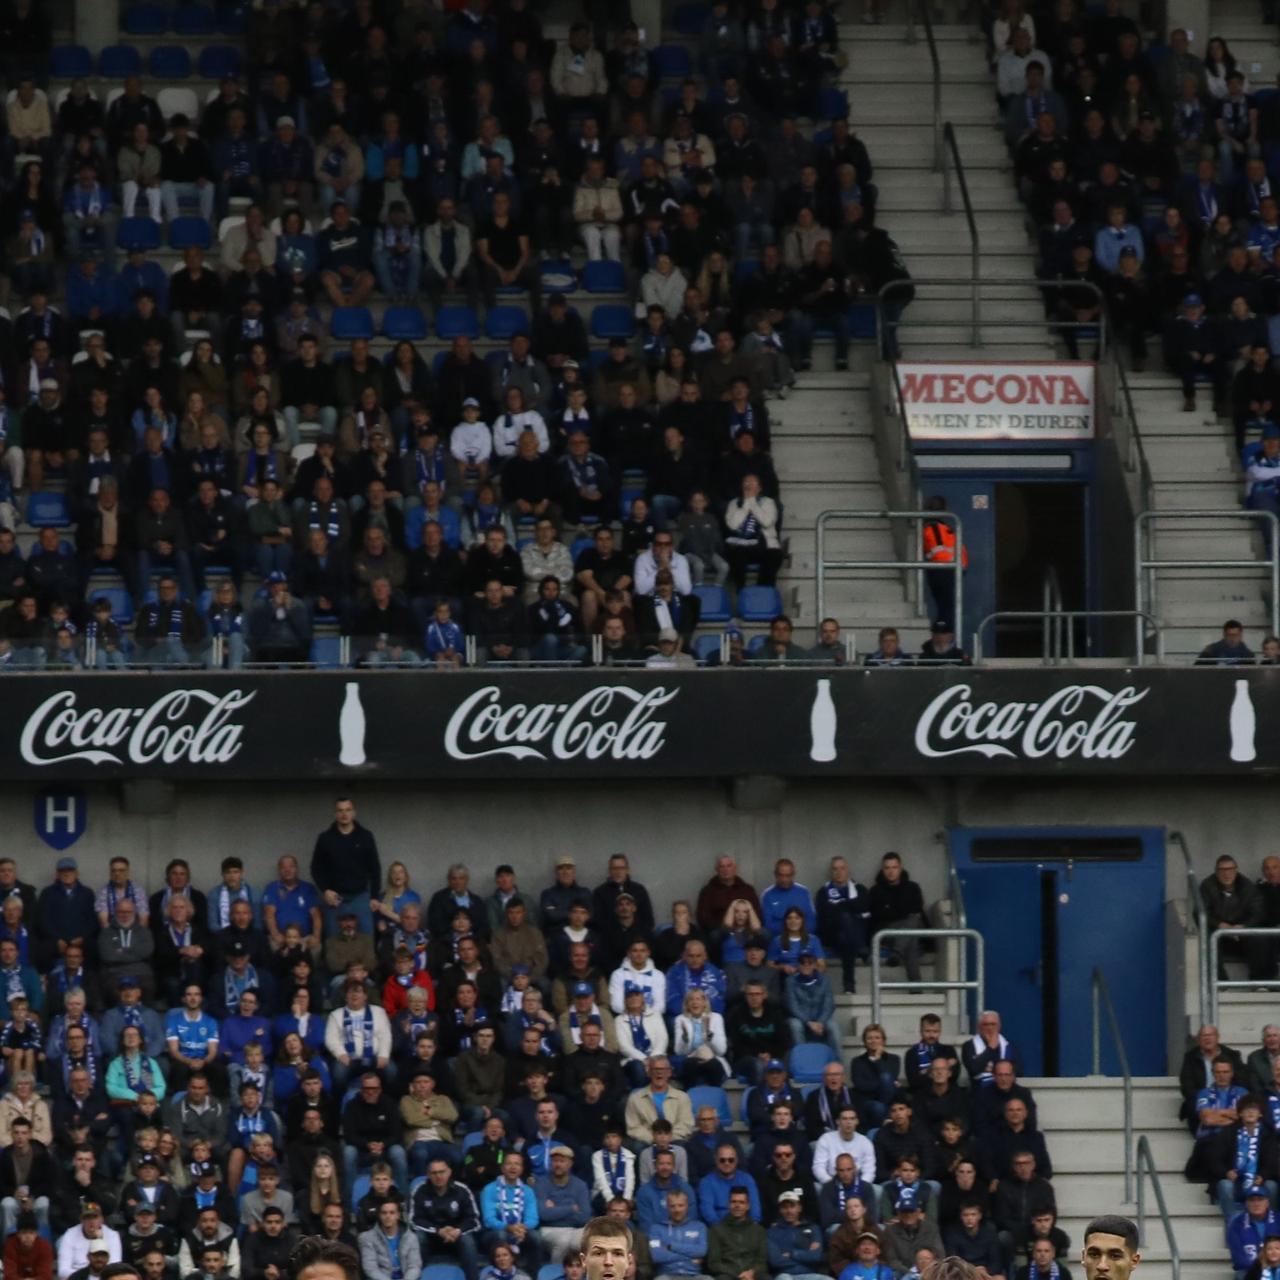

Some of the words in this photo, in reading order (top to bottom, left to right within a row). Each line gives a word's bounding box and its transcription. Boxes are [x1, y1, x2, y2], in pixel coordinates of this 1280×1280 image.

[899, 373, 1090, 404] MECONA
[910, 414, 969, 429] AMEN
[975, 414, 1003, 429] EN
[1008, 414, 1089, 430] DEUREN
[21, 690, 254, 764] Coca-Cola
[445, 686, 678, 759] Coca-Cola
[915, 684, 1149, 758] Coca-Cola
[45, 796, 76, 833] H
